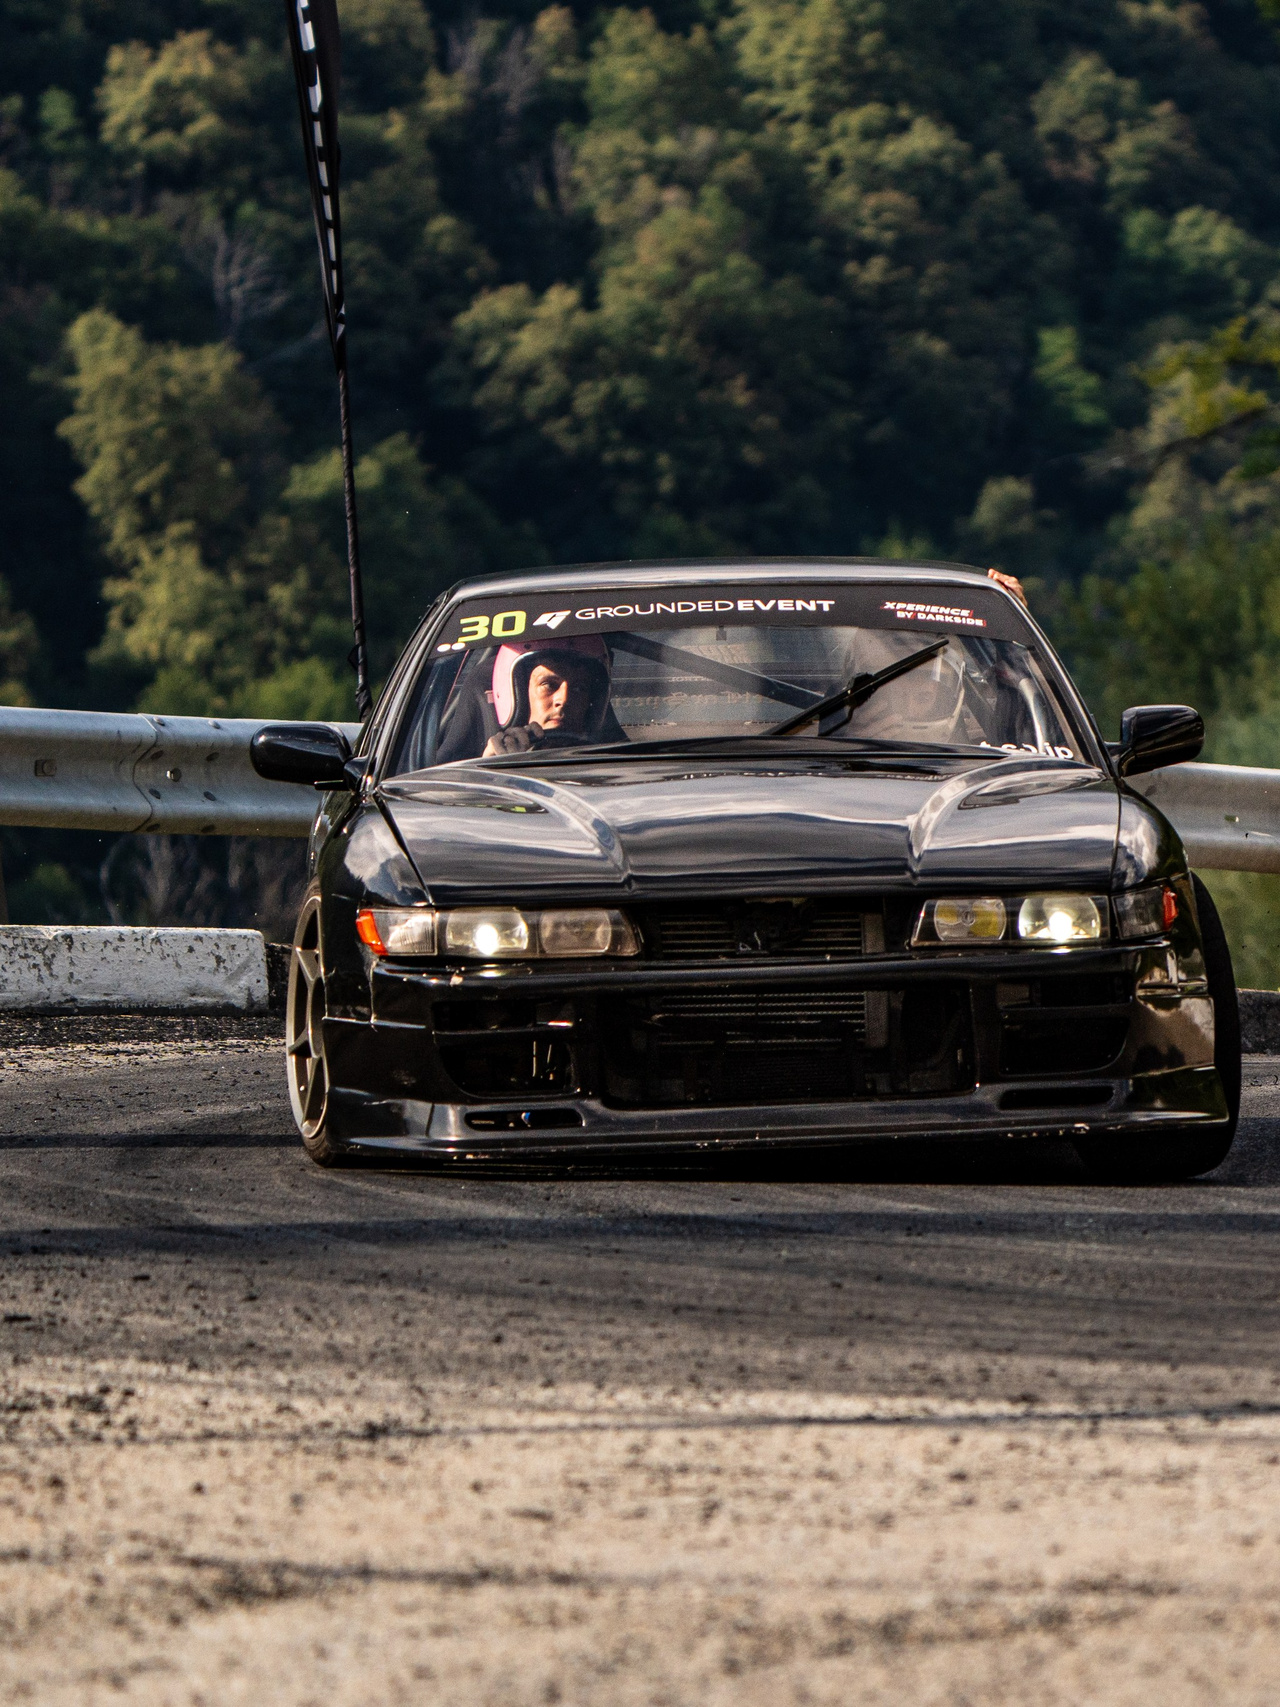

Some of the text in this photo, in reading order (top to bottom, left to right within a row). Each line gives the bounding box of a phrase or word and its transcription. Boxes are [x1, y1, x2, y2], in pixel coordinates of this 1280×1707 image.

[883, 601, 971, 617] XPERIENCE
[457, 610, 527, 643] 30
[896, 610, 985, 627] BY DARKSIDE
